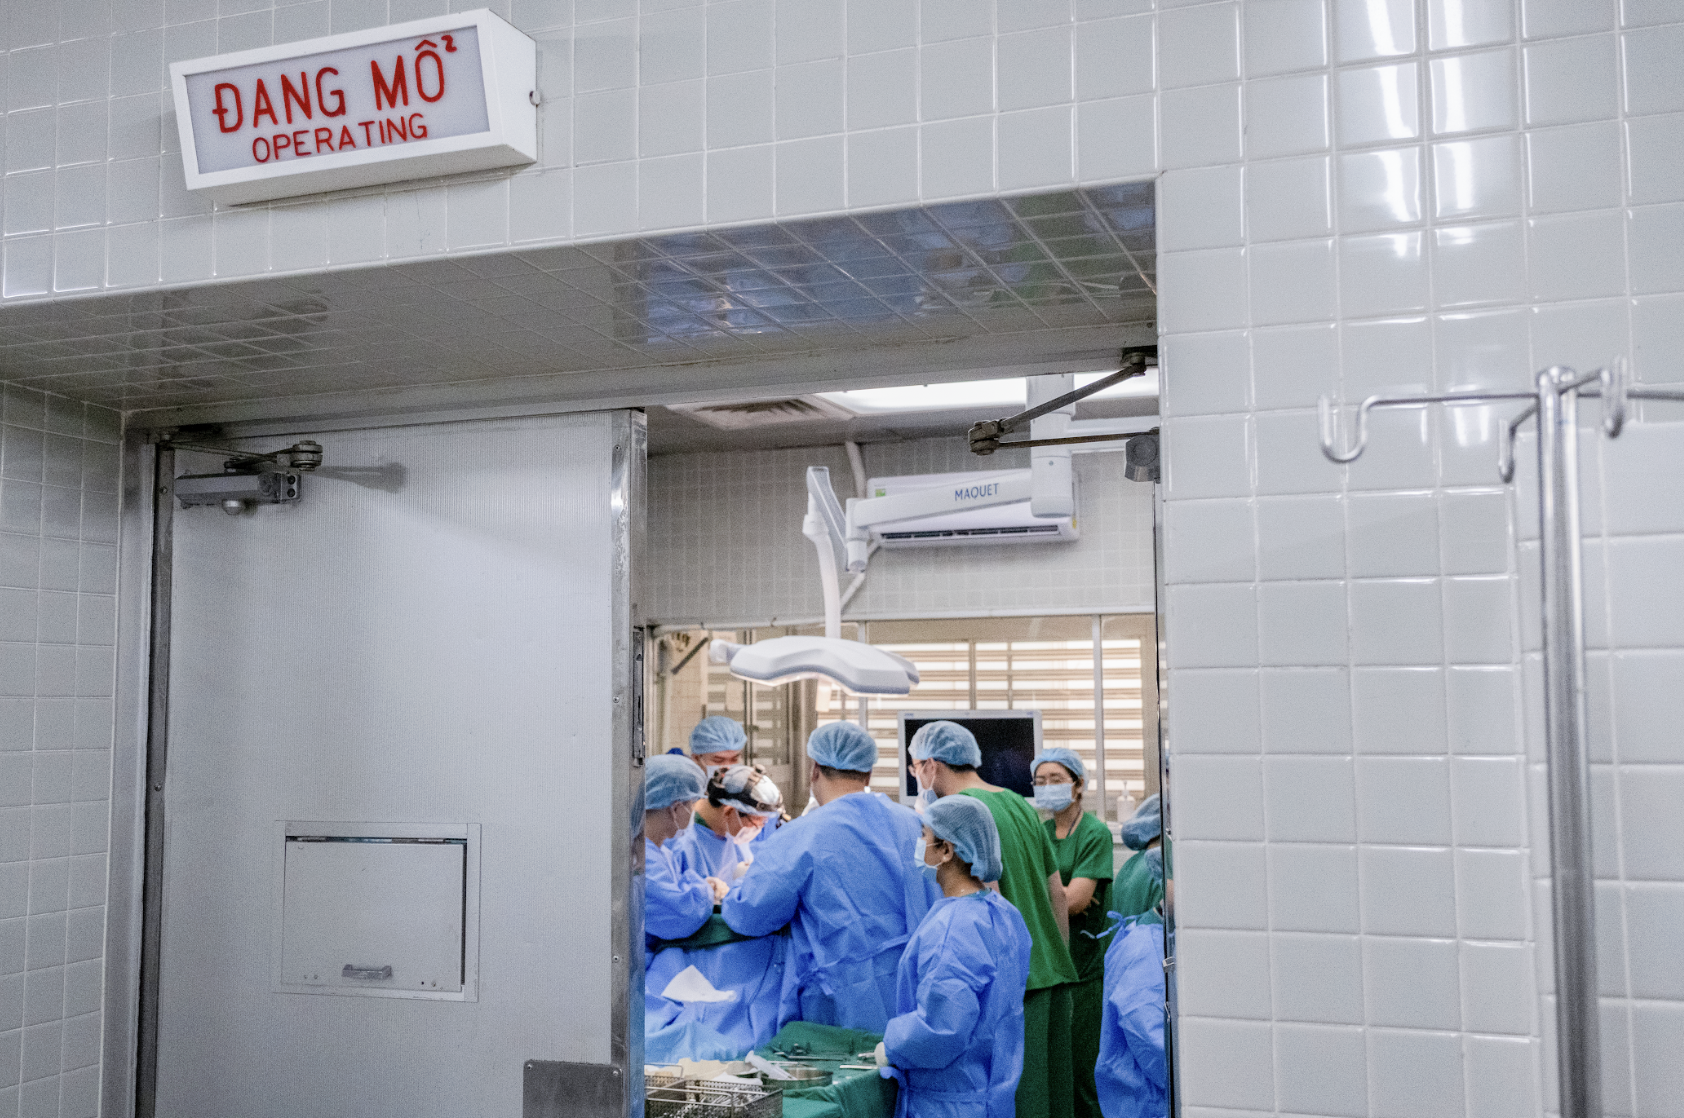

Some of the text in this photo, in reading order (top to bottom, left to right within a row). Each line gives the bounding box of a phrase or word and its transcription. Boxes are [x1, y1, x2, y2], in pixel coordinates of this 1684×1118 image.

[212, 35, 457, 133] ĐANG MỔ
[252, 113, 428, 163] OPERATING
[954, 483, 999, 501] MAQUET
